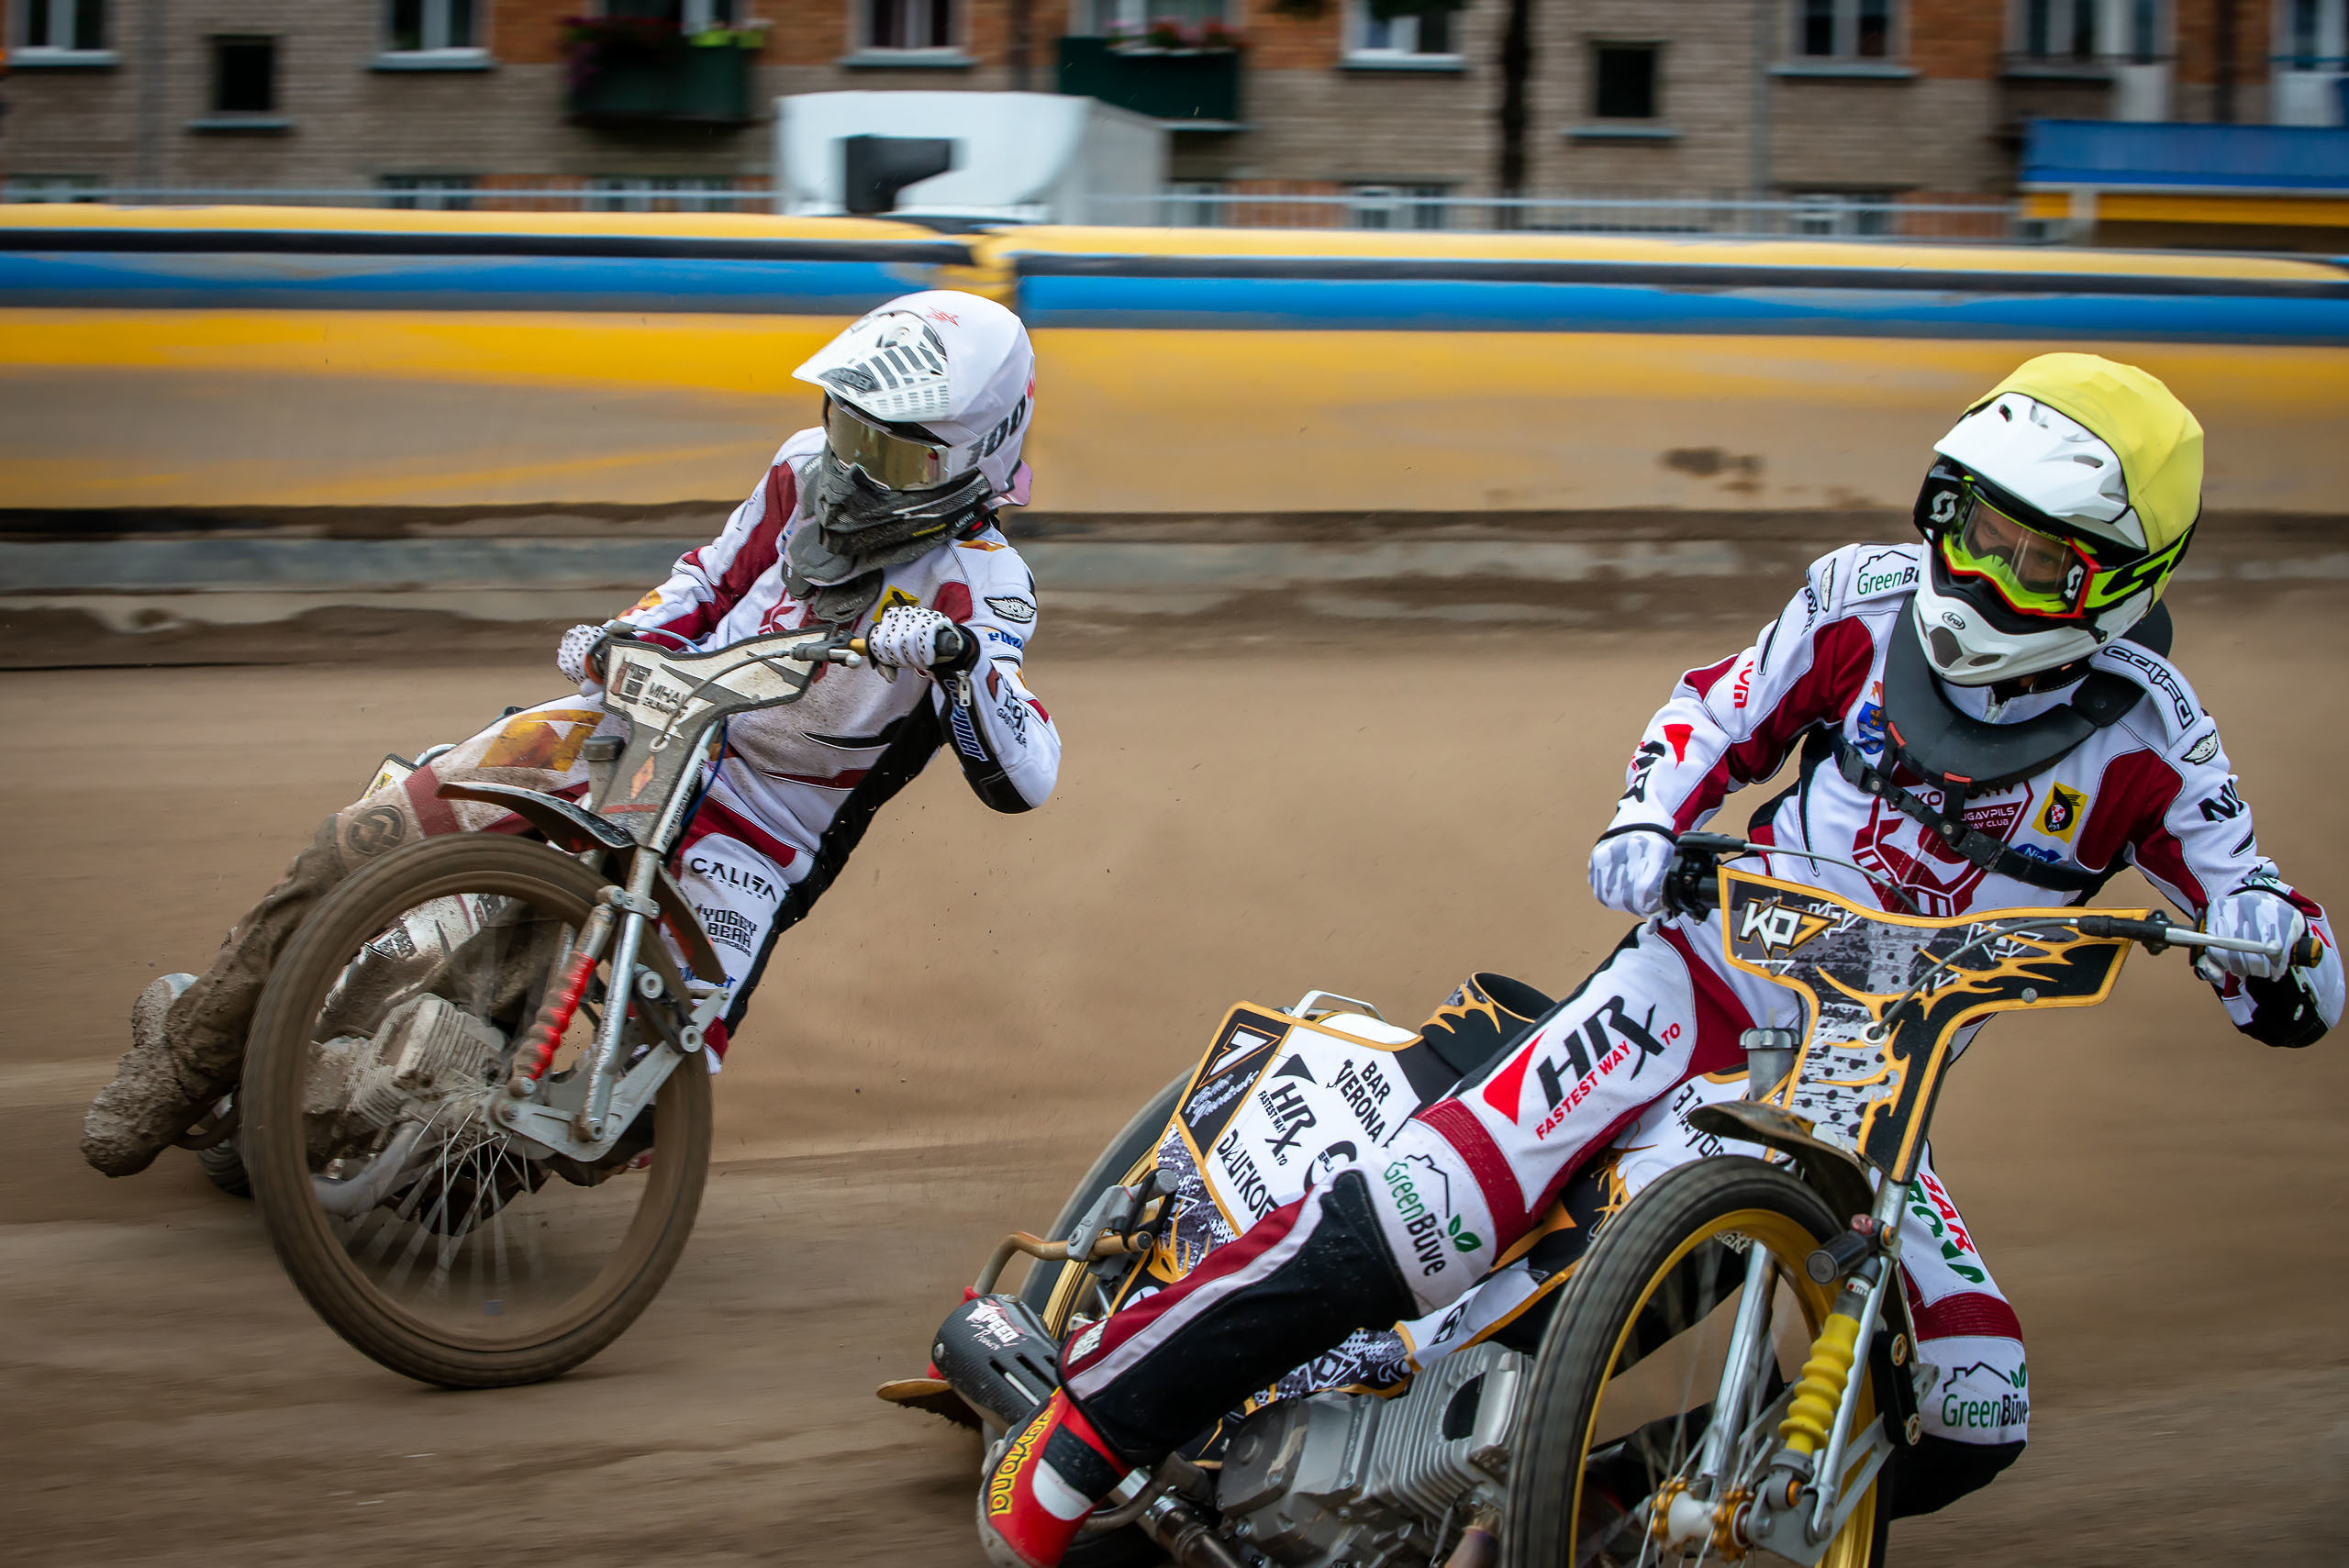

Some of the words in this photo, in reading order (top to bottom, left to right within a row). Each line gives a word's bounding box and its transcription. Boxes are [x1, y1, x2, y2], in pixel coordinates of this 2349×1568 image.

[1986, 818, 2009, 828] CLUB
[1360, 1061, 1391, 1105] BAR
[1535, 1070, 1599, 1140] FASTEST
[1598, 1040, 1631, 1075] WAY
[1661, 1022, 1681, 1046] TO
[1257, 1090, 1278, 1121] FASTEST
[1272, 1106, 1287, 1135] WAY
[1327, 1059, 1390, 1149] VERONA
[1275, 1144, 1286, 1166] TO
[1917, 1171, 1976, 1254] BAR
